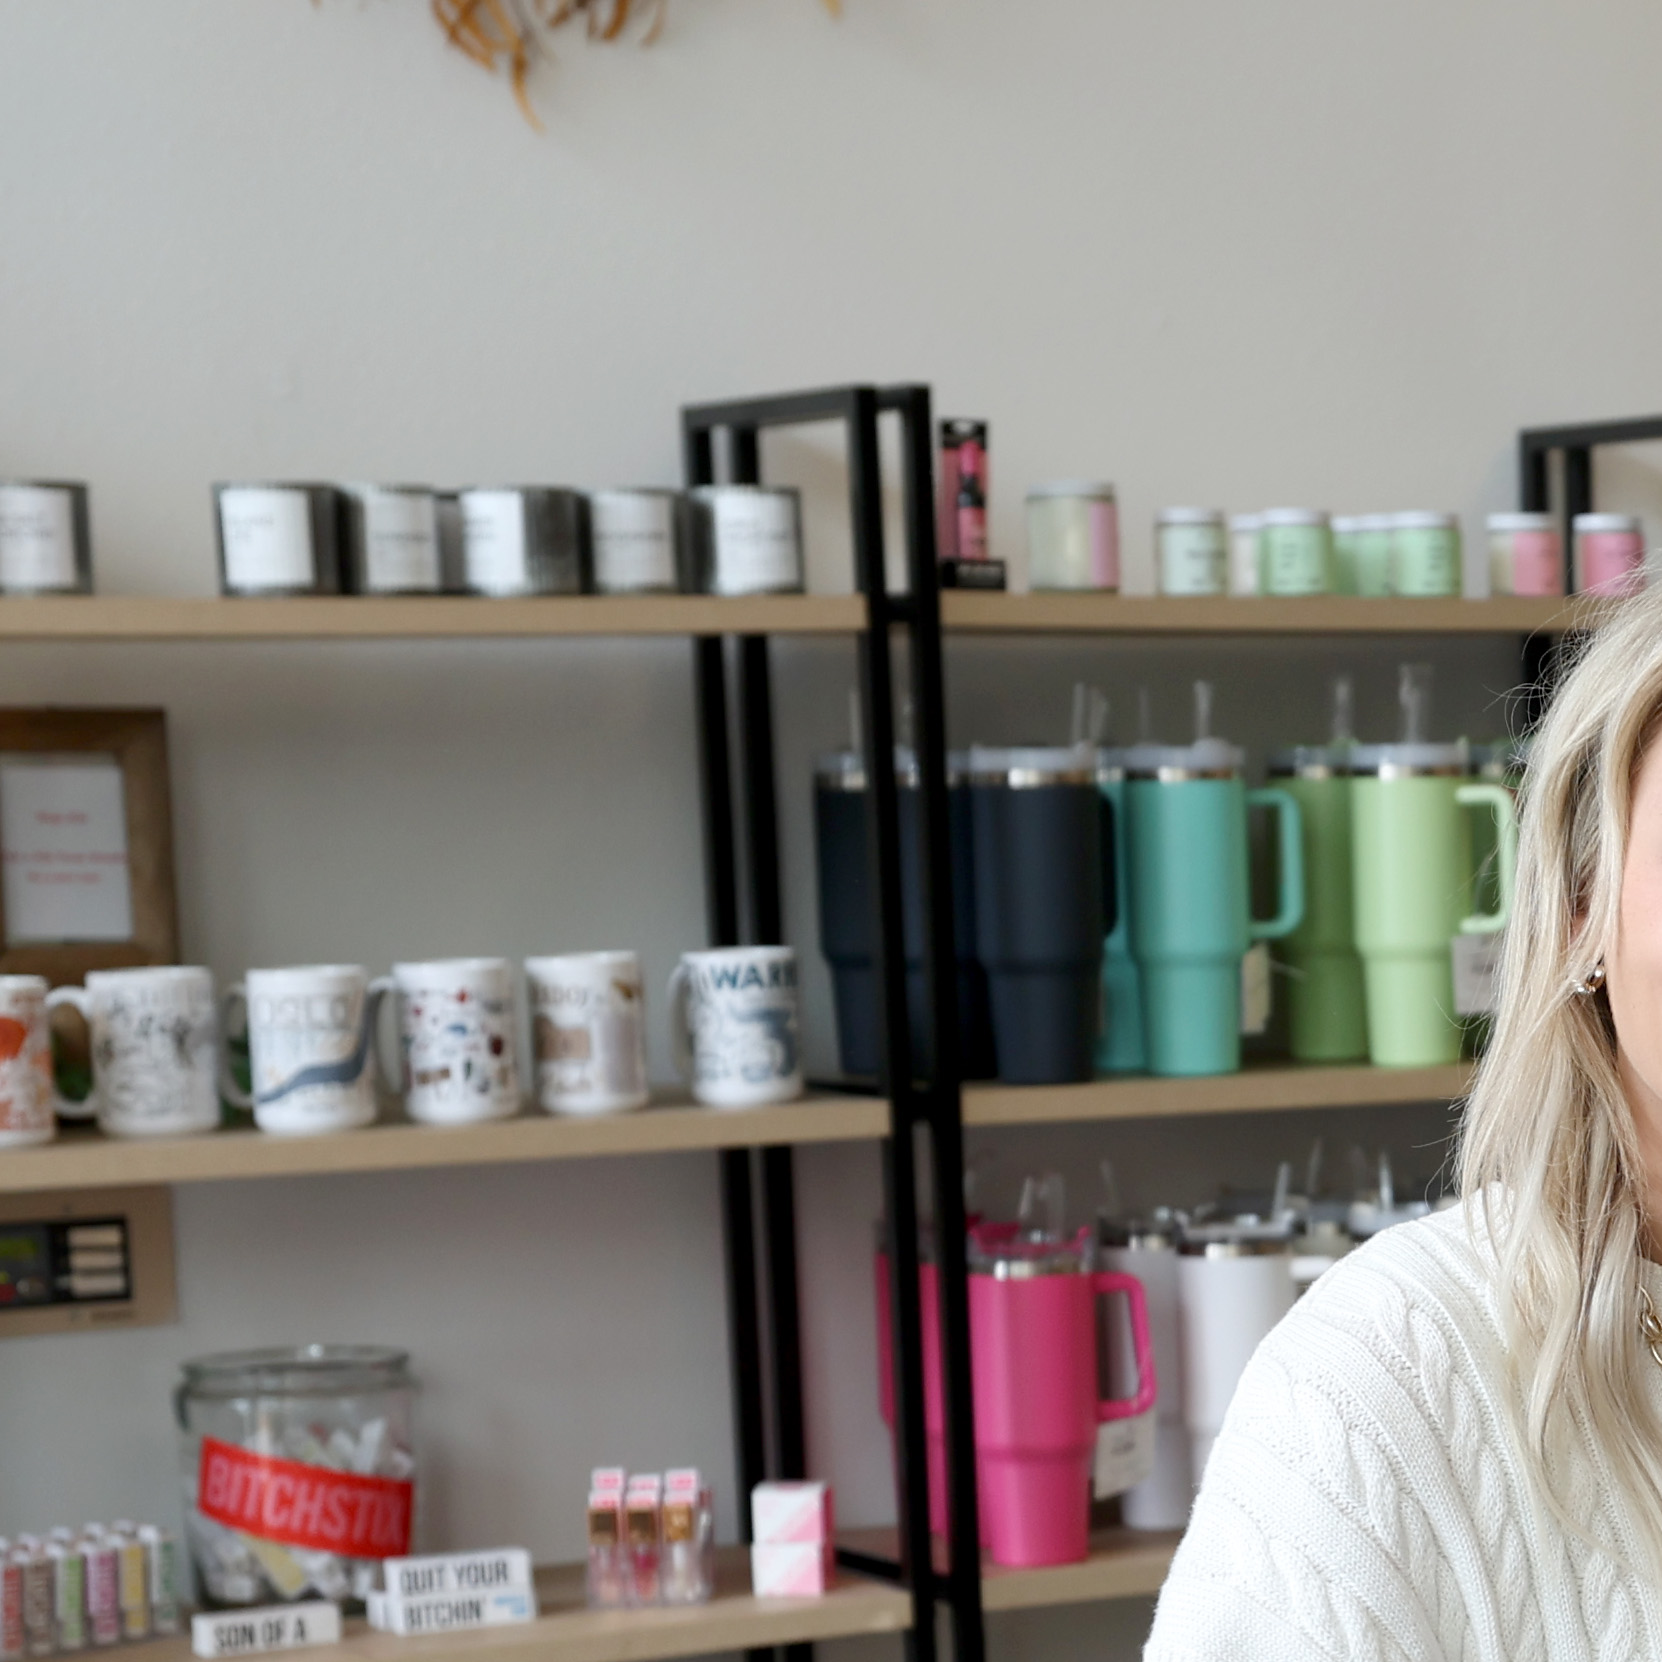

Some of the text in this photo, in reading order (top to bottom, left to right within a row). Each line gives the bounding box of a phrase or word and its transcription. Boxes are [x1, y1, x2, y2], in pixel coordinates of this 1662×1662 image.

[206, 1453, 404, 1548] BITCHSTIX
[401, 1559, 508, 1598] QUIT YOUR
[214, 1617, 306, 1650] SON OF A
